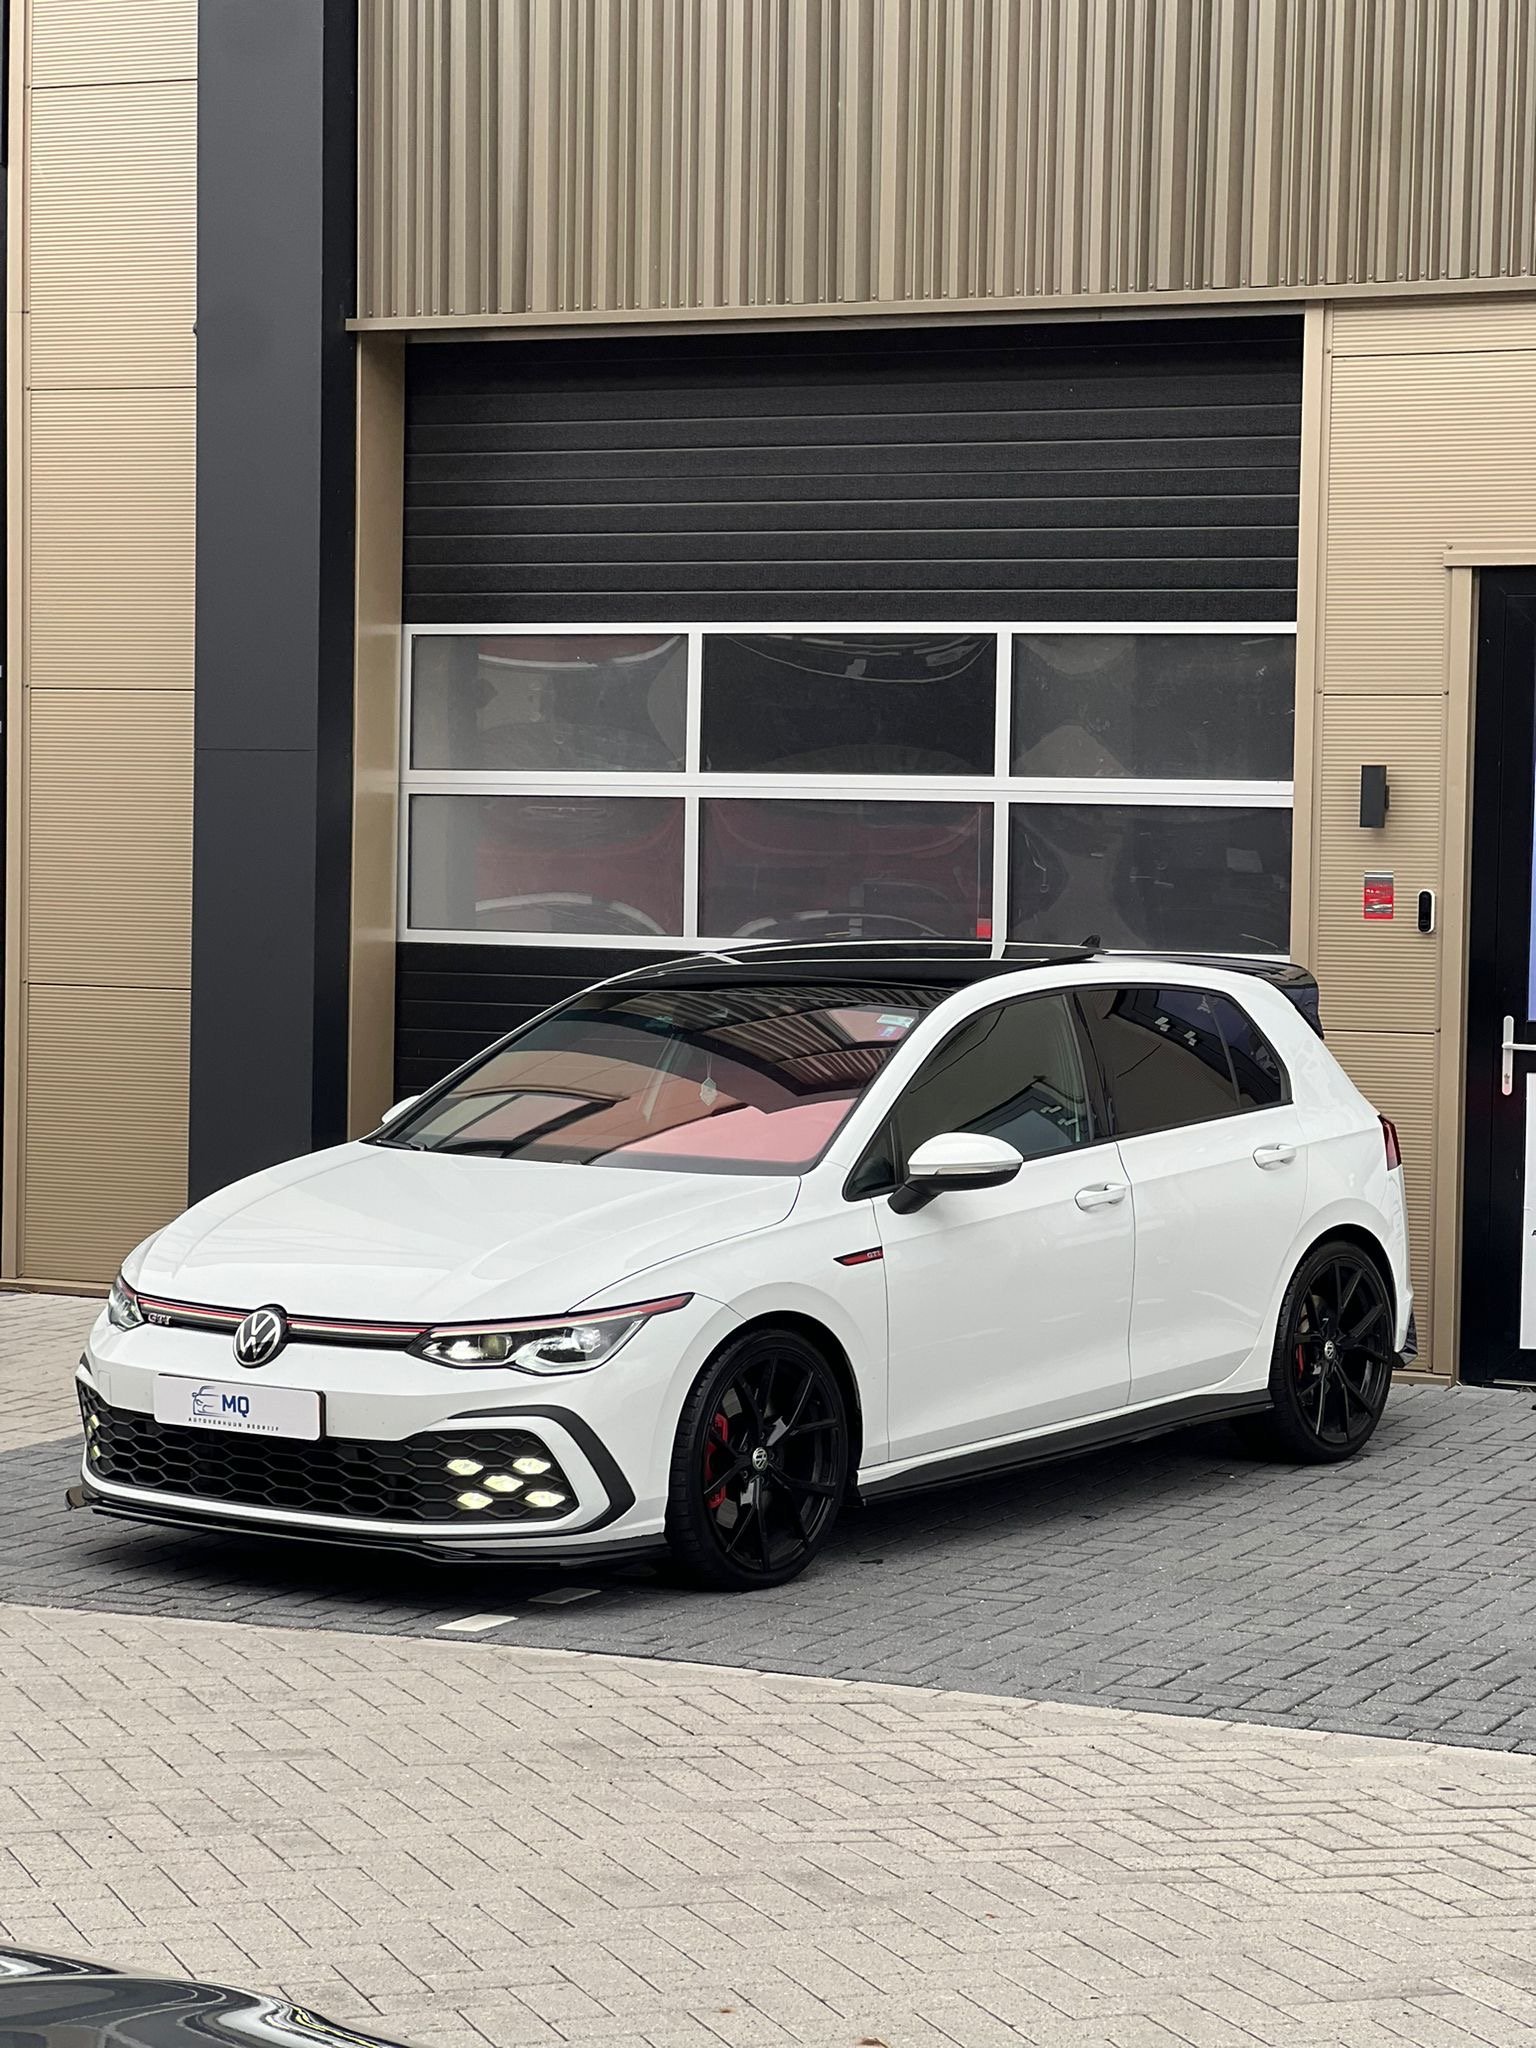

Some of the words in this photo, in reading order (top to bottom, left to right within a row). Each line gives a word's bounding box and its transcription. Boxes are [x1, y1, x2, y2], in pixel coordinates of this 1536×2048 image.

[866, 1250, 881, 1258] GTI
[147, 1312, 171, 1325] GTI
[221, 1394, 250, 1418] MQ
